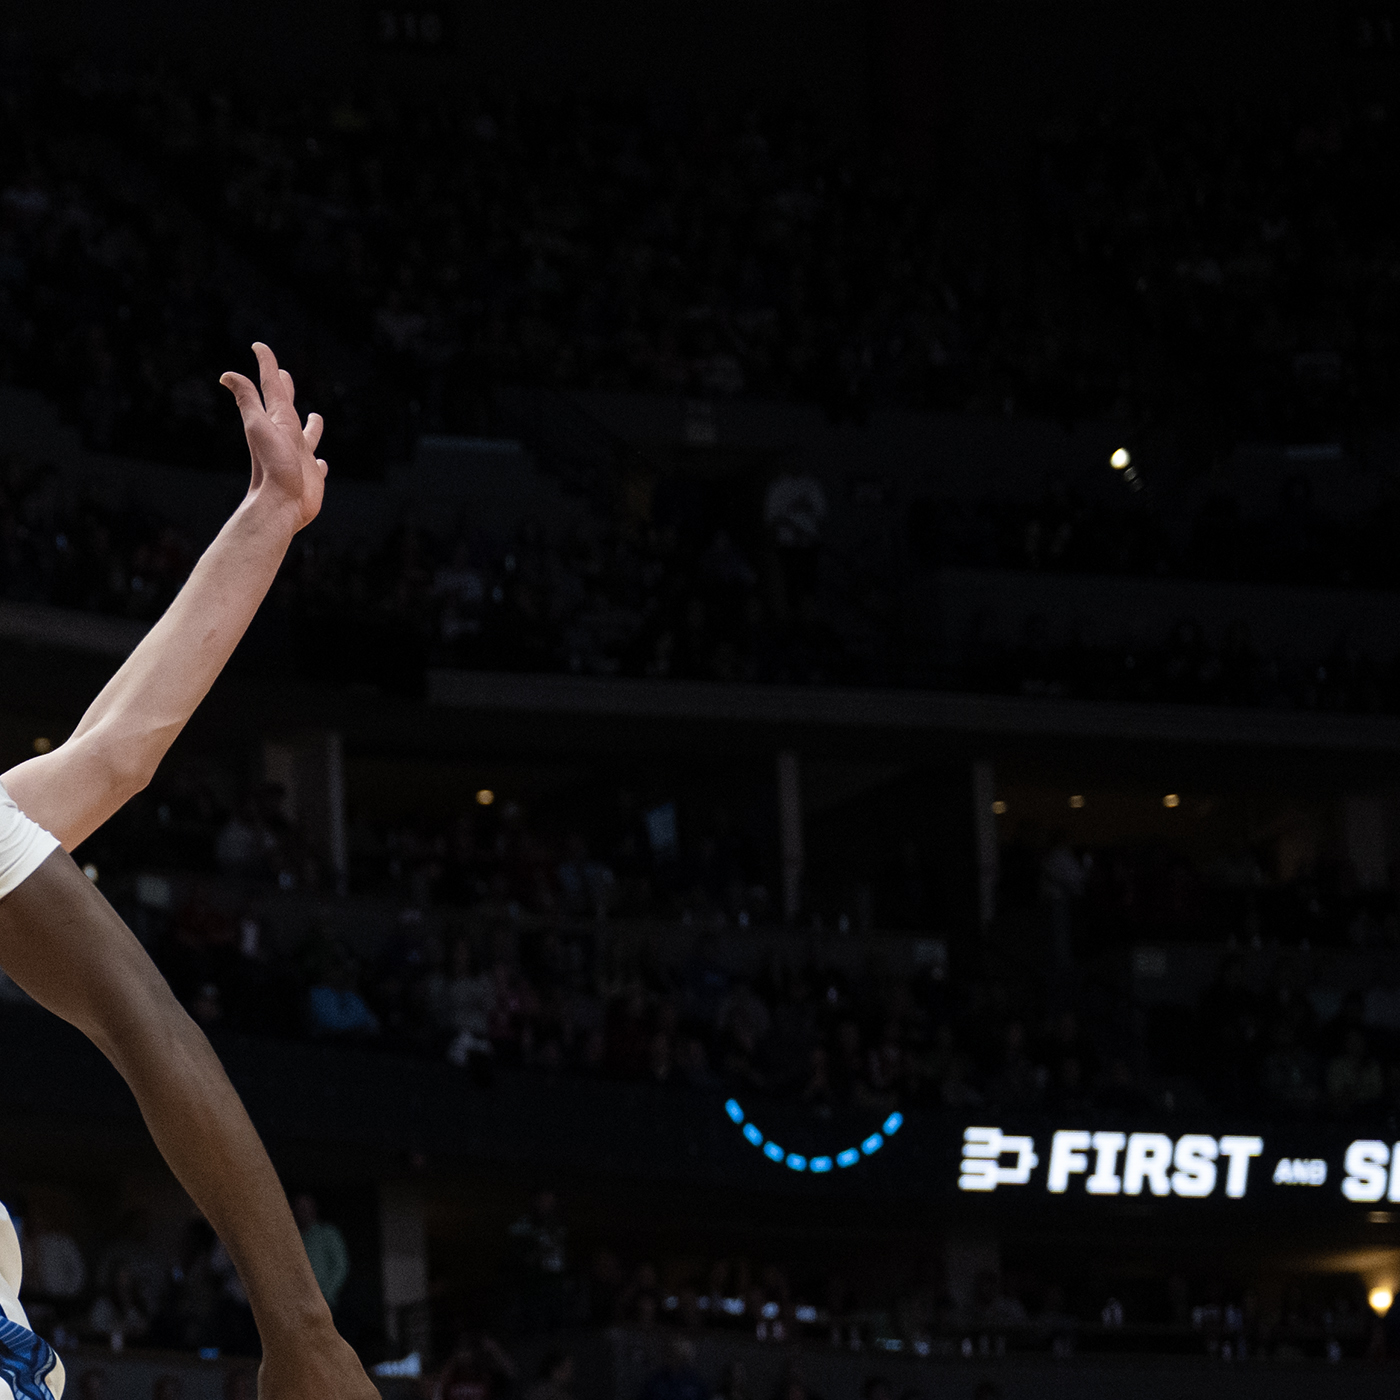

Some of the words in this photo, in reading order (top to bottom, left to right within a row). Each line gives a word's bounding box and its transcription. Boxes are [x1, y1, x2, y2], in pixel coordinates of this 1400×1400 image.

[1047, 1130, 1264, 1200] FIRST
[1272, 1157, 1328, 1187] AND
[1341, 1139, 1400, 1204] S
